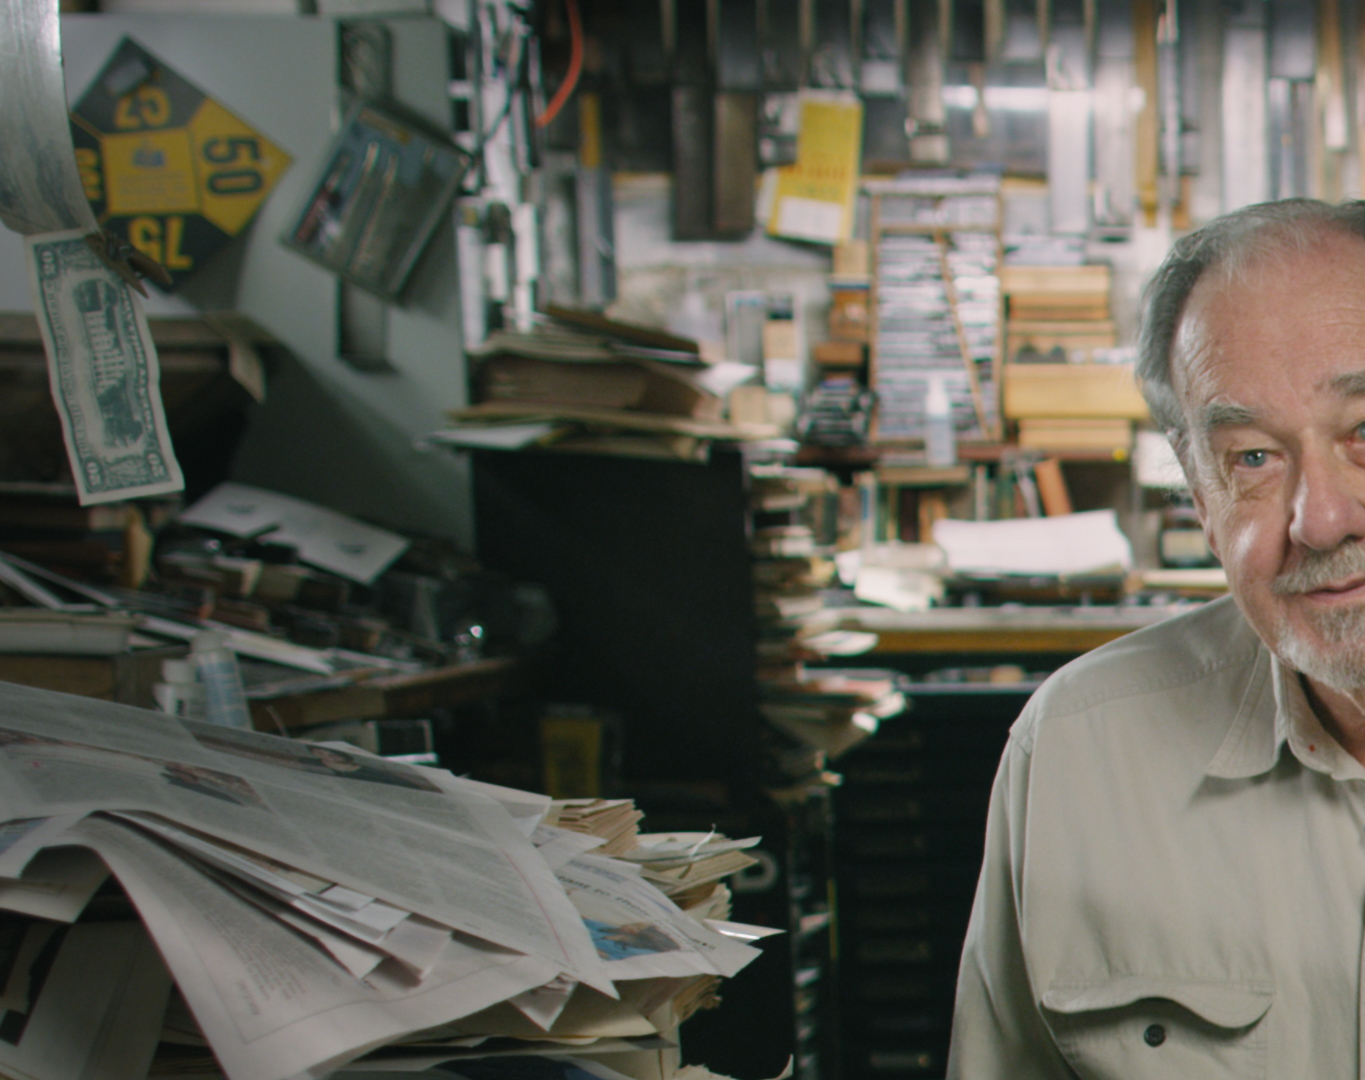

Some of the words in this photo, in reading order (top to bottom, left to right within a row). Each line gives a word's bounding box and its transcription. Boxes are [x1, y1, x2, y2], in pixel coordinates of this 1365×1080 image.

[201, 135, 264, 196] 50
[128, 216, 194, 271] 75
[39, 249, 58, 277] 20
[85, 460, 103, 487] 20
[147, 451, 166, 479] 20
